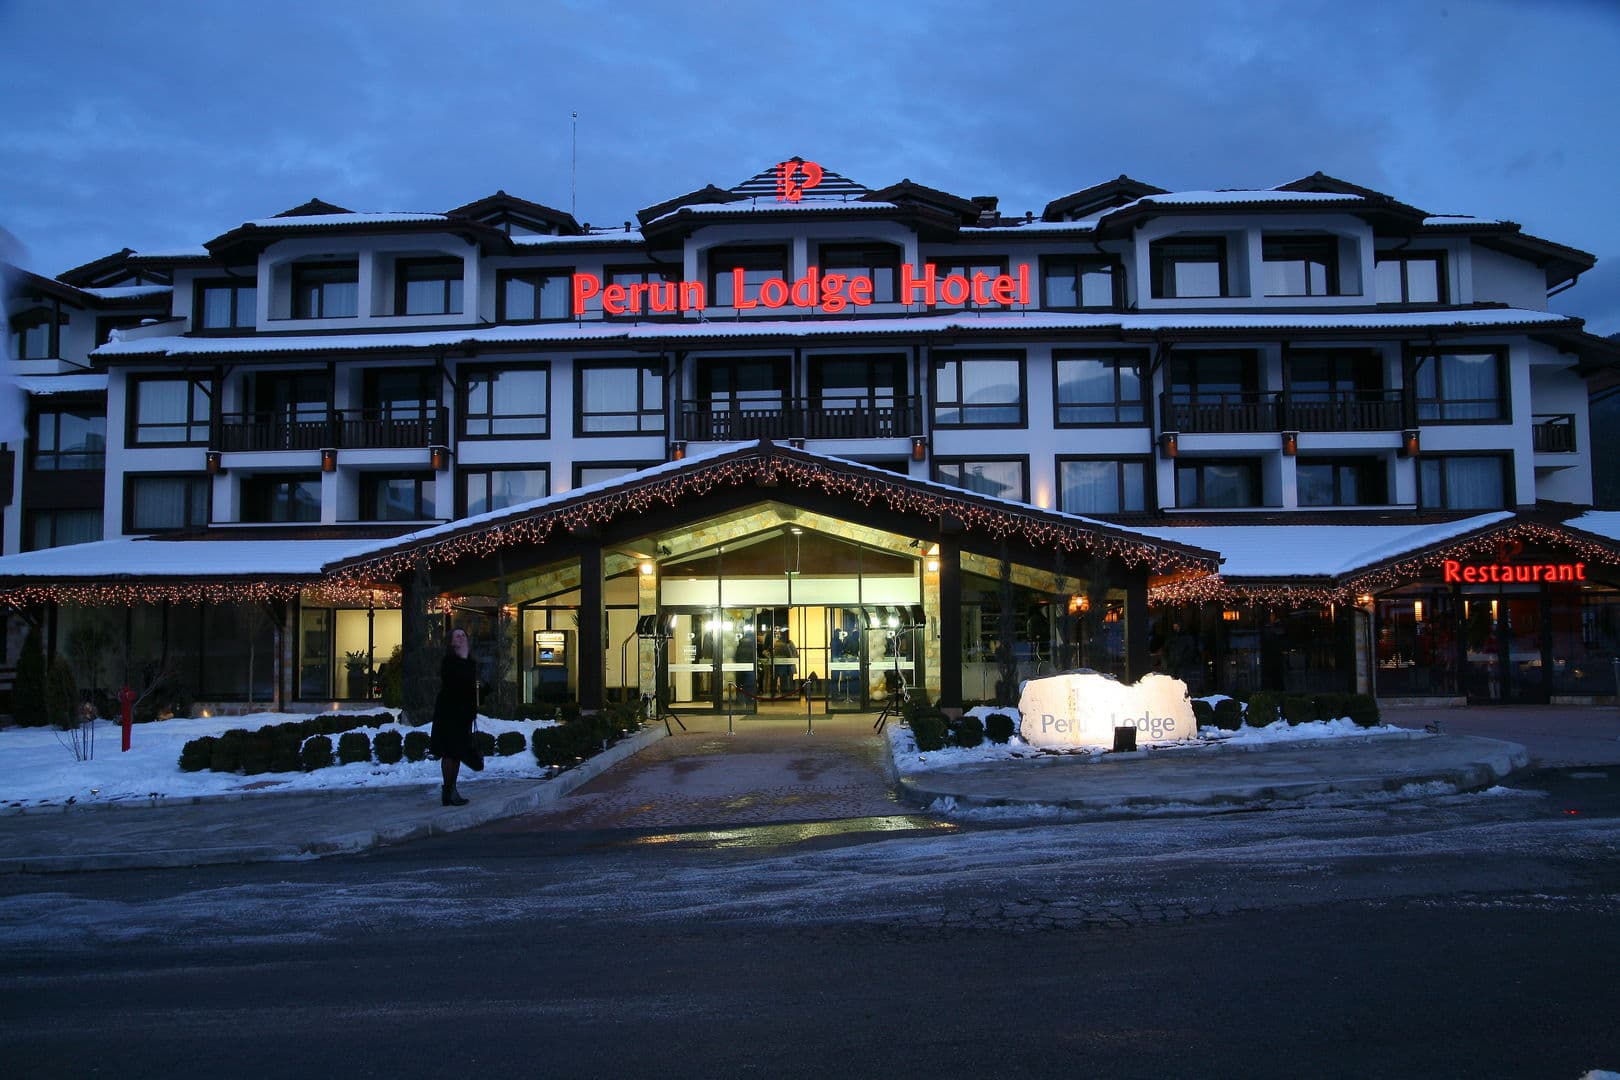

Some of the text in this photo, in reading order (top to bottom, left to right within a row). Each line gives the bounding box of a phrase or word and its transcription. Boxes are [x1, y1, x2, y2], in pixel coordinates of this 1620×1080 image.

[573, 263, 1030, 315] Perun Lodge Hotel
[1444, 560, 1585, 582] Restaurant
